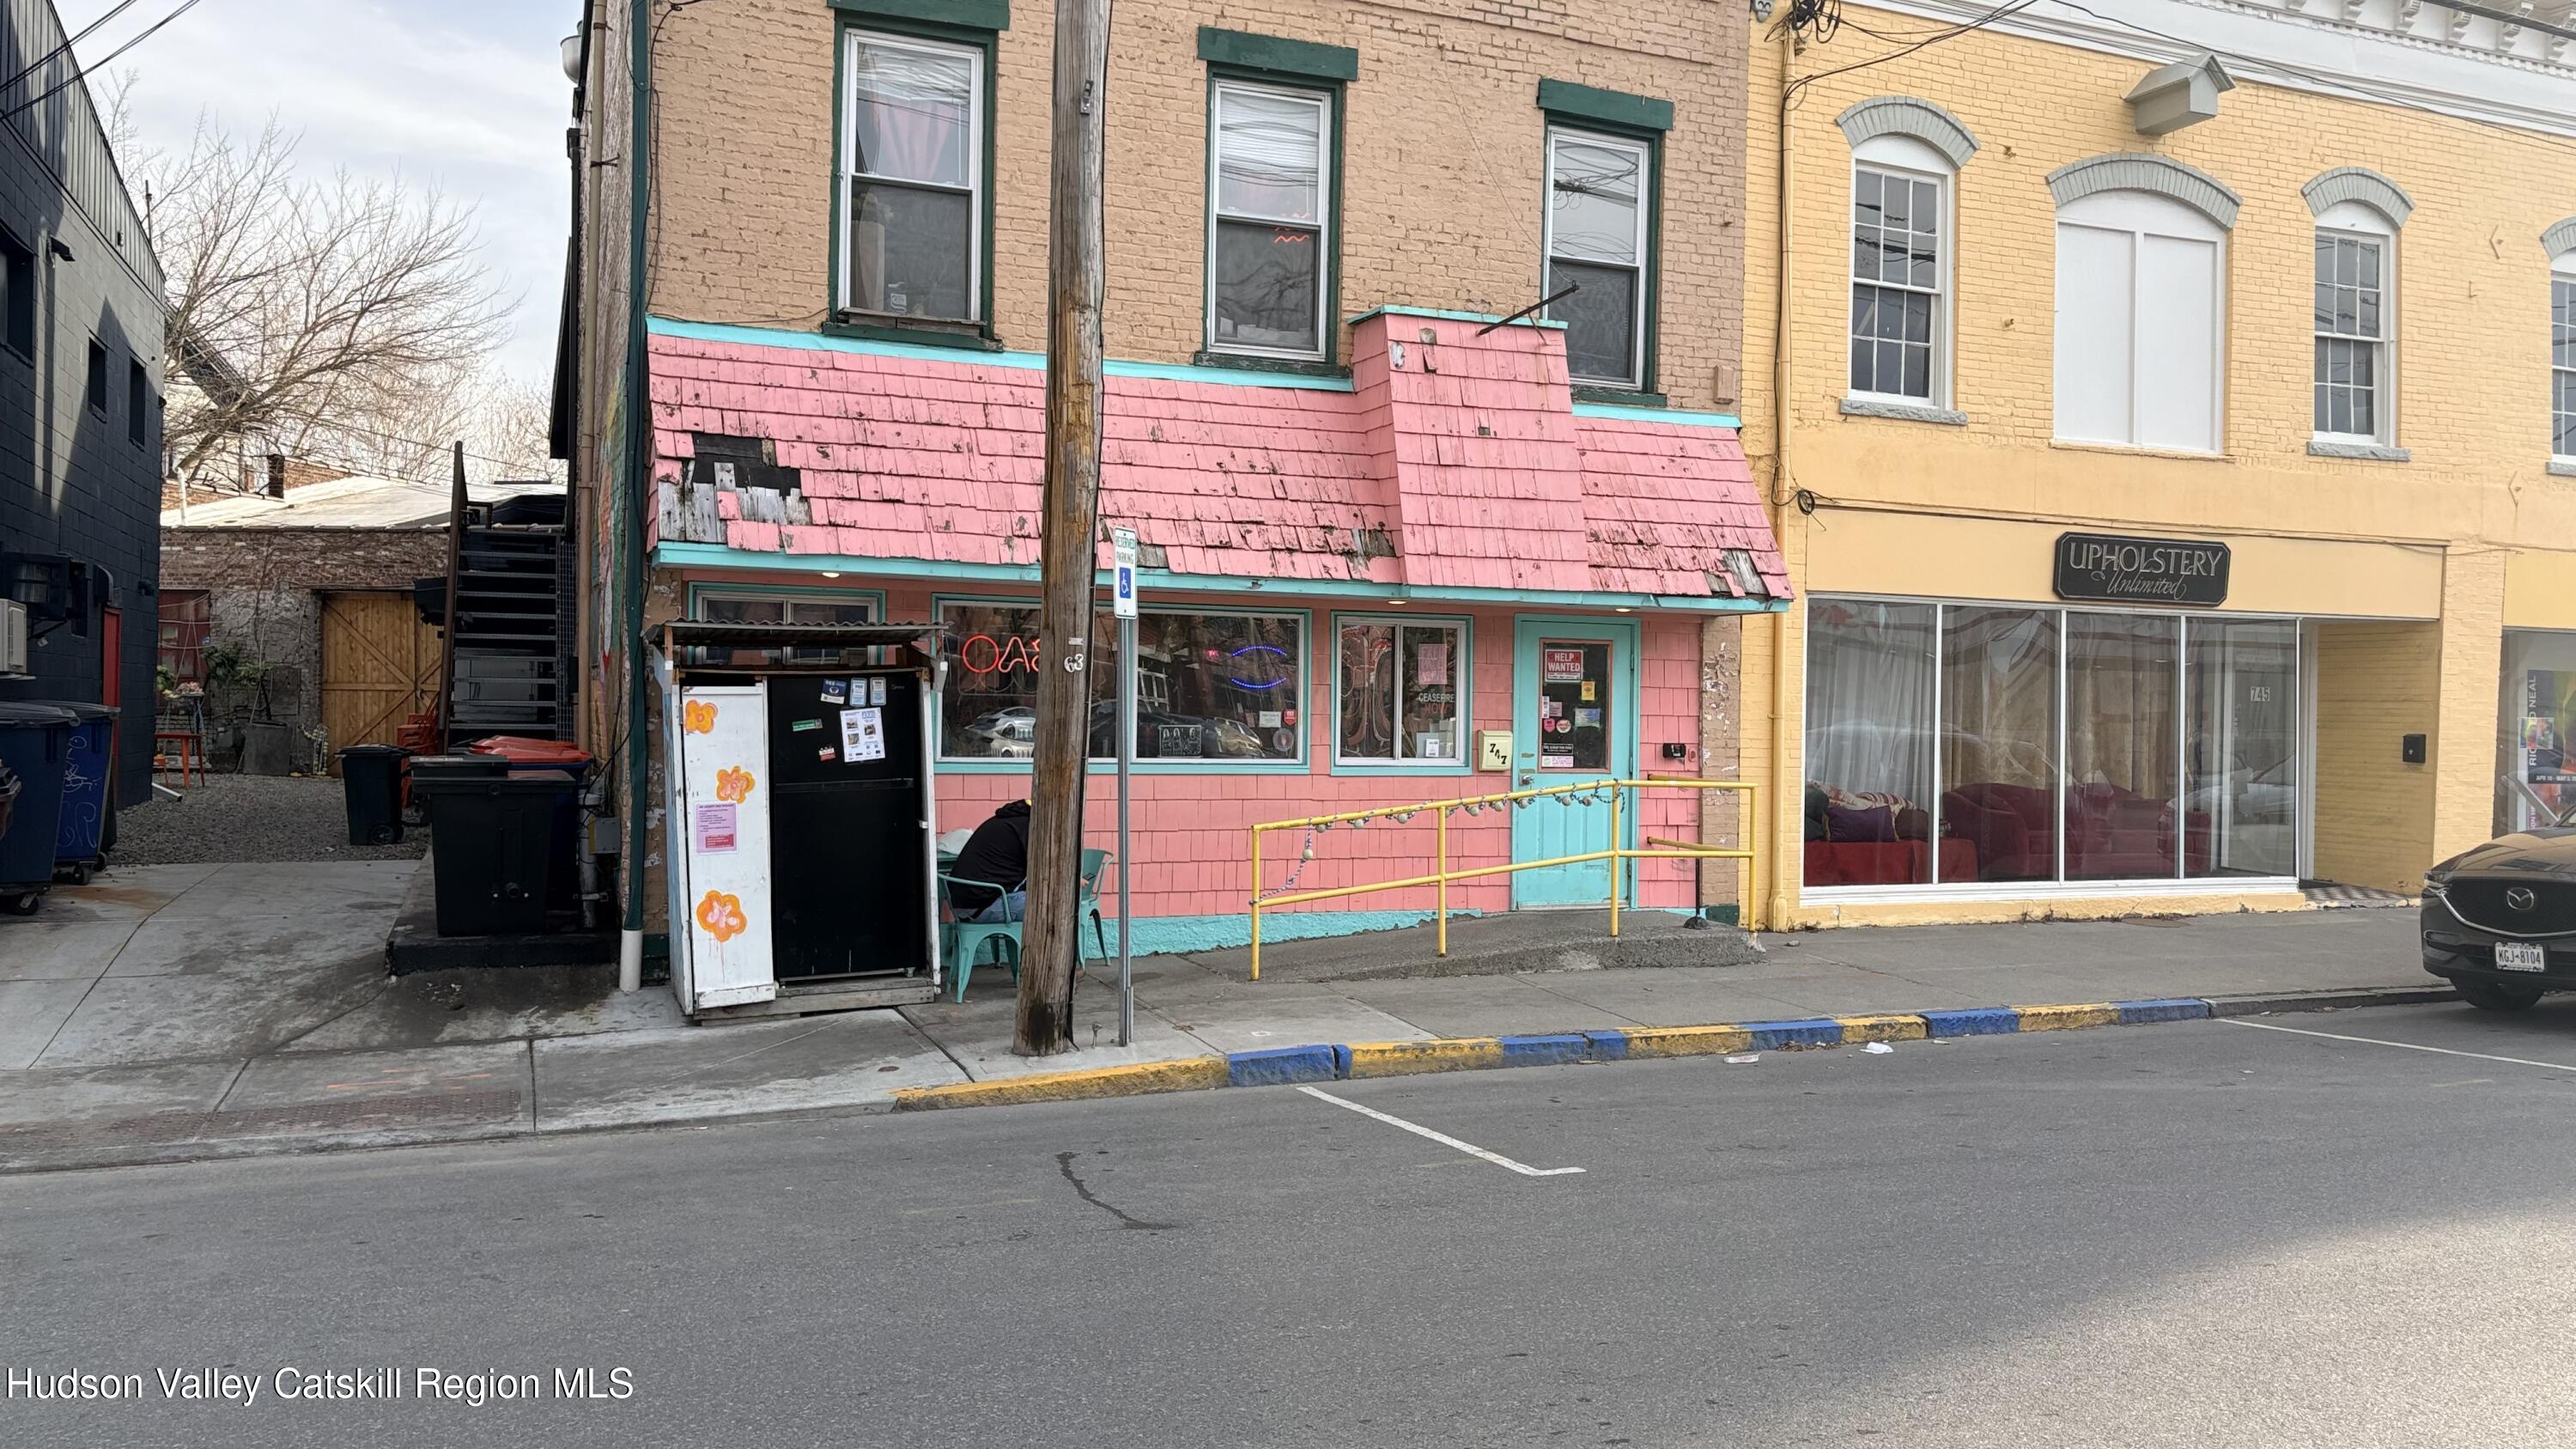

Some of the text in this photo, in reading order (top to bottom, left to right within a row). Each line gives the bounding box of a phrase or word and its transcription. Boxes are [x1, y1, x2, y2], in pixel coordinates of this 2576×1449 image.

[1116, 536, 1135, 550] RESERVED
[1116, 551, 1134, 564] PARKING
[2069, 541, 2223, 576] UPHOLSTERY
[2091, 567, 2187, 600] Unlimited
[1064, 653, 1084, 673] 63
[1554, 652, 1575, 662] HELP
[1547, 662, 1581, 672] WANTED
[1419, 692, 1456, 703] CEASEFIRE
[2251, 687, 2270, 702] 745
[2528, 674, 2537, 708] NEAL
